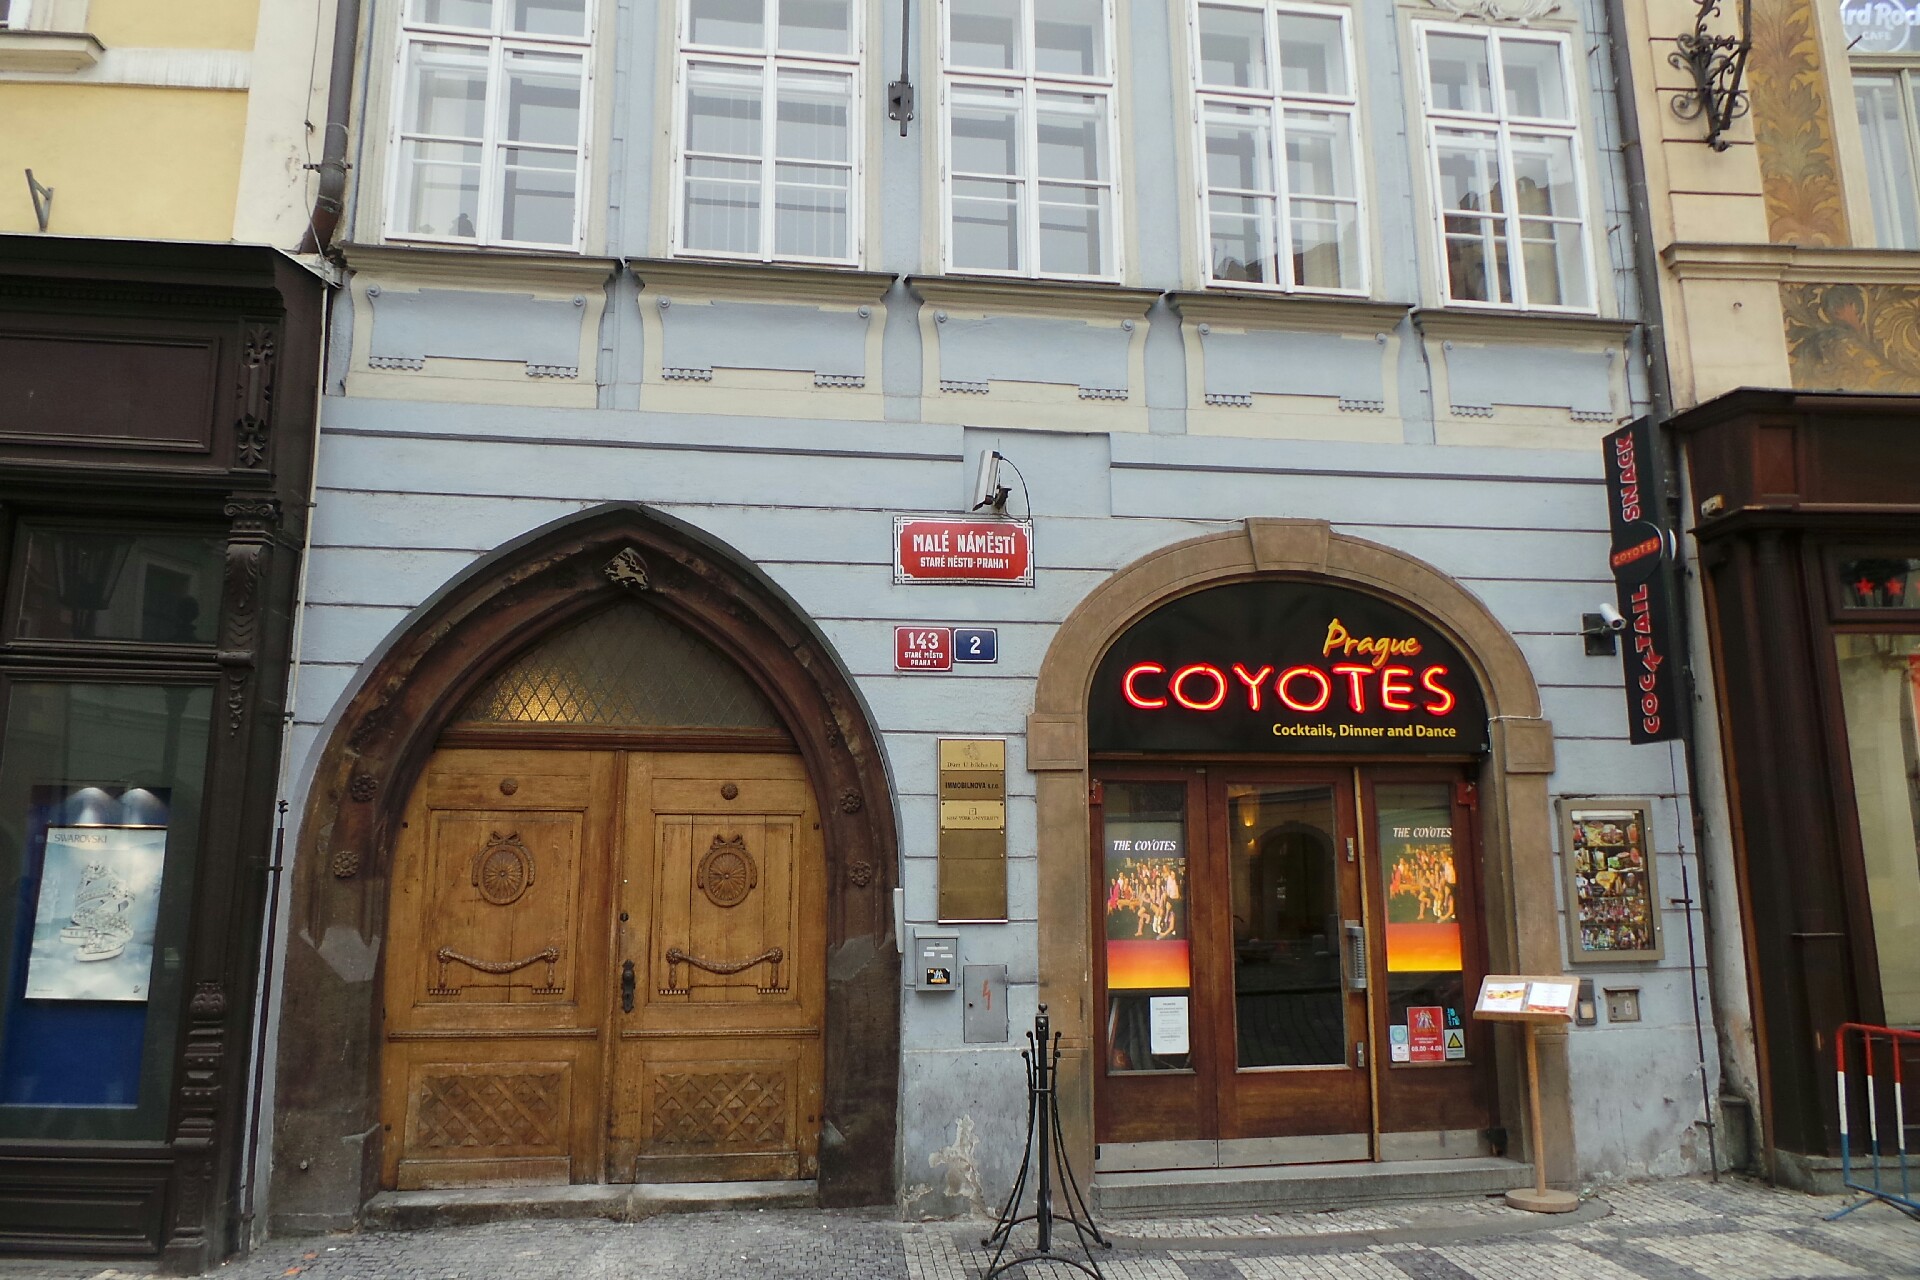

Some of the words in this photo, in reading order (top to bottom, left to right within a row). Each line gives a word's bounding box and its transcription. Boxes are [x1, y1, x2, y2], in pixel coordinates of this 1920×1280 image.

[1874, 2, 1920, 31] Roc
[1615, 431, 1640, 523] SNACK
[913, 530, 950, 552] MALÉ
[957, 530, 1016, 554] NÁMĚSTÍ
[920, 555, 946, 568] STARÉ
[1613, 537, 1659, 567] COYOTES
[908, 631, 939, 650] 143
[969, 635, 982, 655] 2
[1322, 617, 1422, 668] Prague
[904, 650, 922, 659] STARÉ
[923, 650, 944, 659] MĚSTO
[933, 659, 938, 667] 1
[1631, 583, 1664, 735] COCKTAIL
[1121, 661, 1456, 717] COYOTES
[1272, 723, 1336, 738] Cocktails,
[1339, 724, 1384, 737] Dinner
[1387, 724, 1413, 737] and
[1415, 724, 1457, 737] Dance
[54, 833, 108, 844] SWAROVSKI
[1393, 827, 1410, 838] THE
[1412, 826, 1453, 838] COYOTES
[1113, 840, 1131, 851] THE
[1134, 839, 1176, 851] COYOTES
